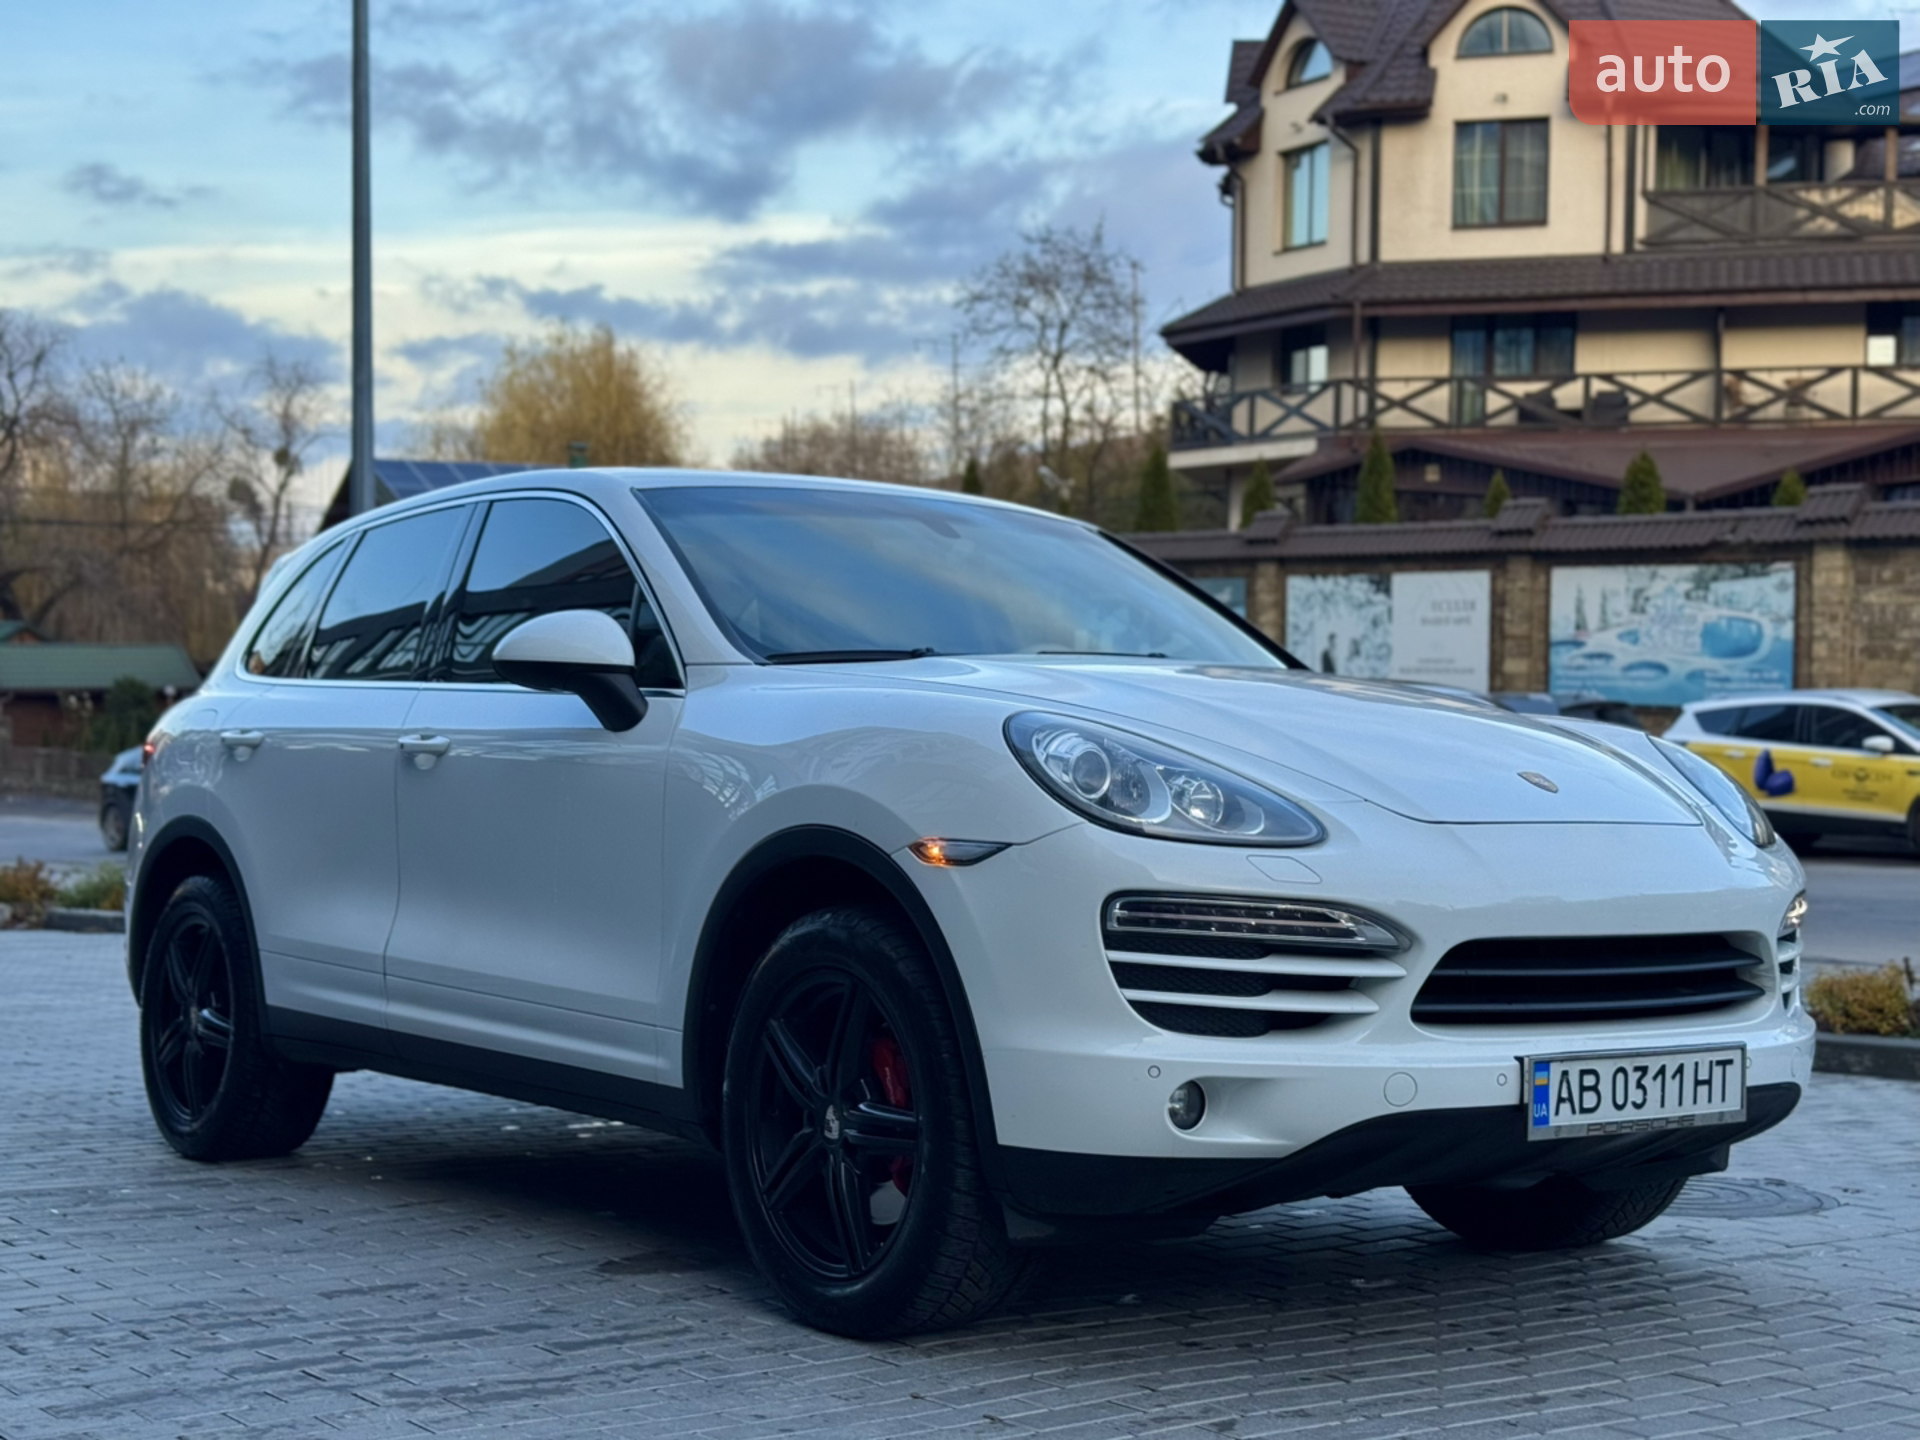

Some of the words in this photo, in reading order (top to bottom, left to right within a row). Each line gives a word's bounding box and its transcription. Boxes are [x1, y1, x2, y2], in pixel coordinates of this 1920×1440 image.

[1554, 1068, 1602, 1117] AB
[1611, 1062, 1685, 1112] 0311
[1693, 1058, 1734, 1106] HT
[1533, 1103, 1548, 1118] UA
[1586, 1114, 1696, 1136] PORSCHE
